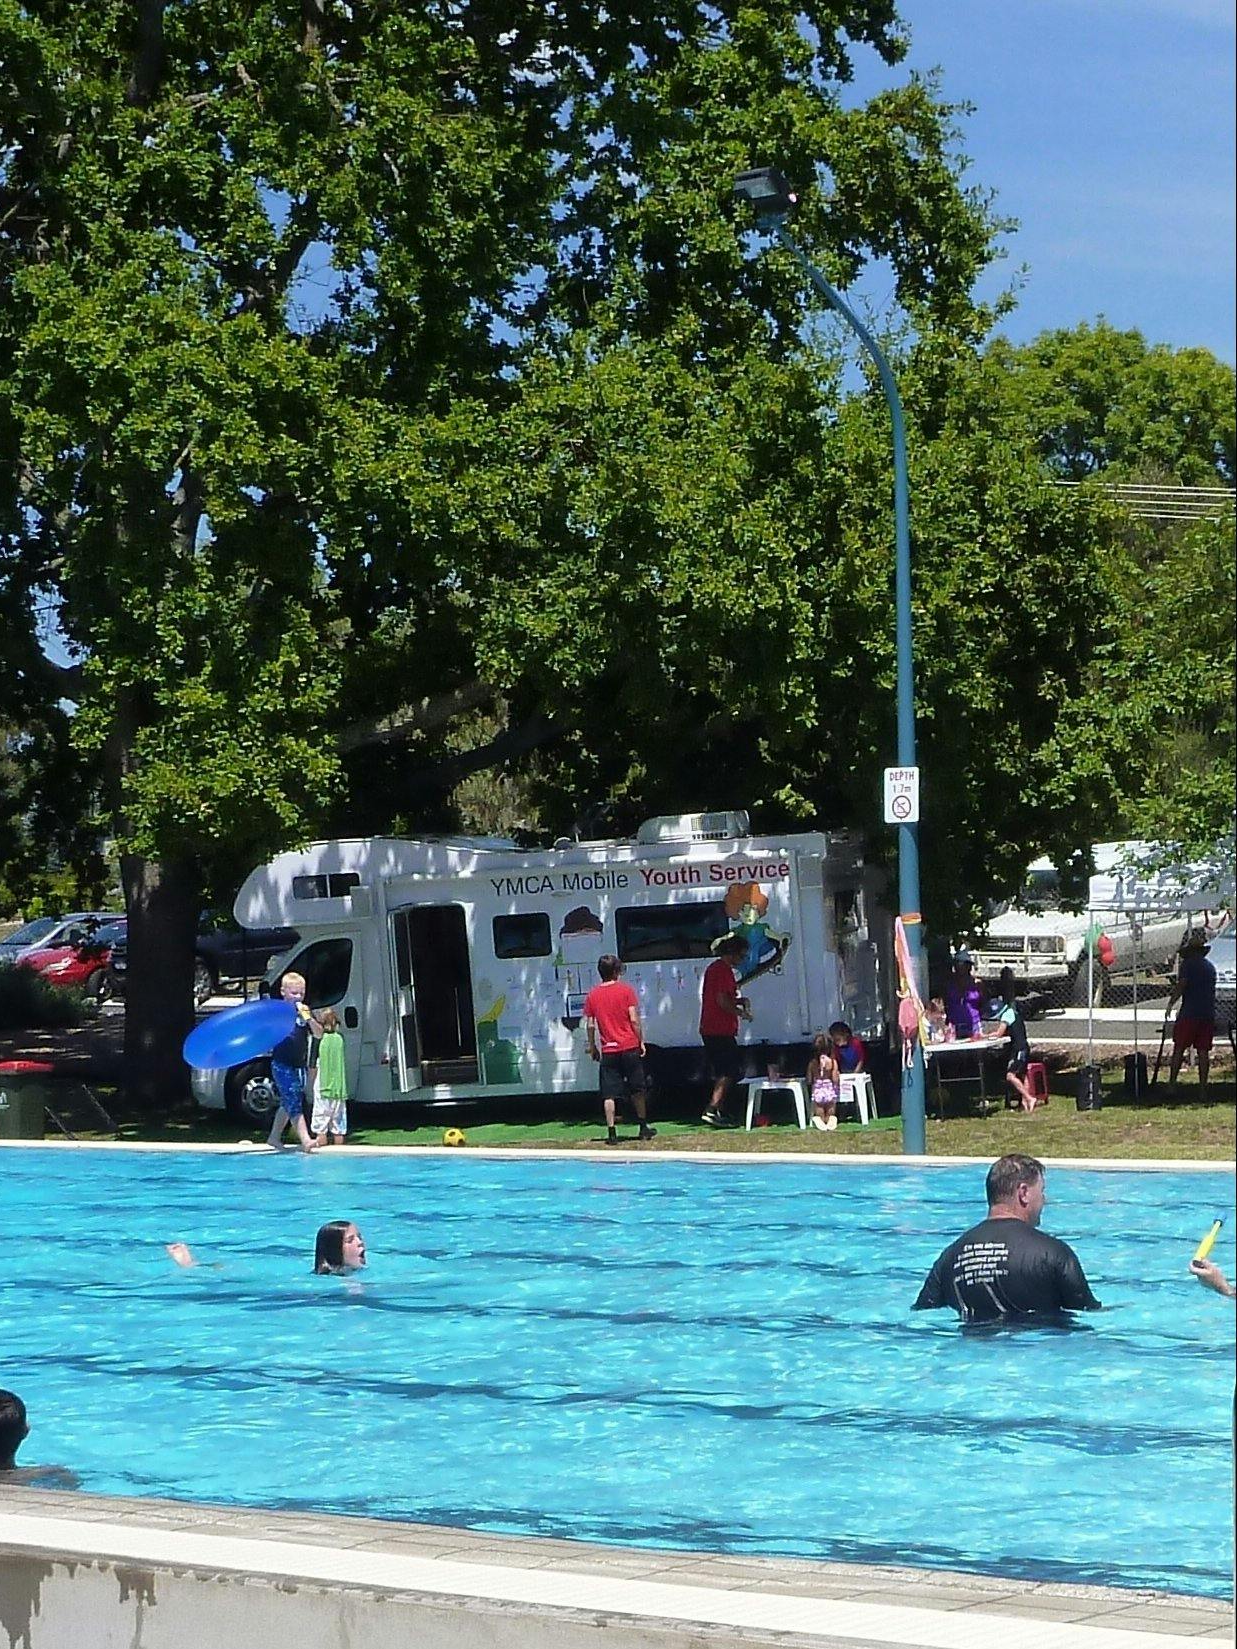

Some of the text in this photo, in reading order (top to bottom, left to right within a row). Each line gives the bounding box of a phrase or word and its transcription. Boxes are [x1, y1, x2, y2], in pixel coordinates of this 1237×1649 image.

[889, 770, 915, 781] DEPTH
[490, 861, 791, 897] YMCA Mobile Youth Service
